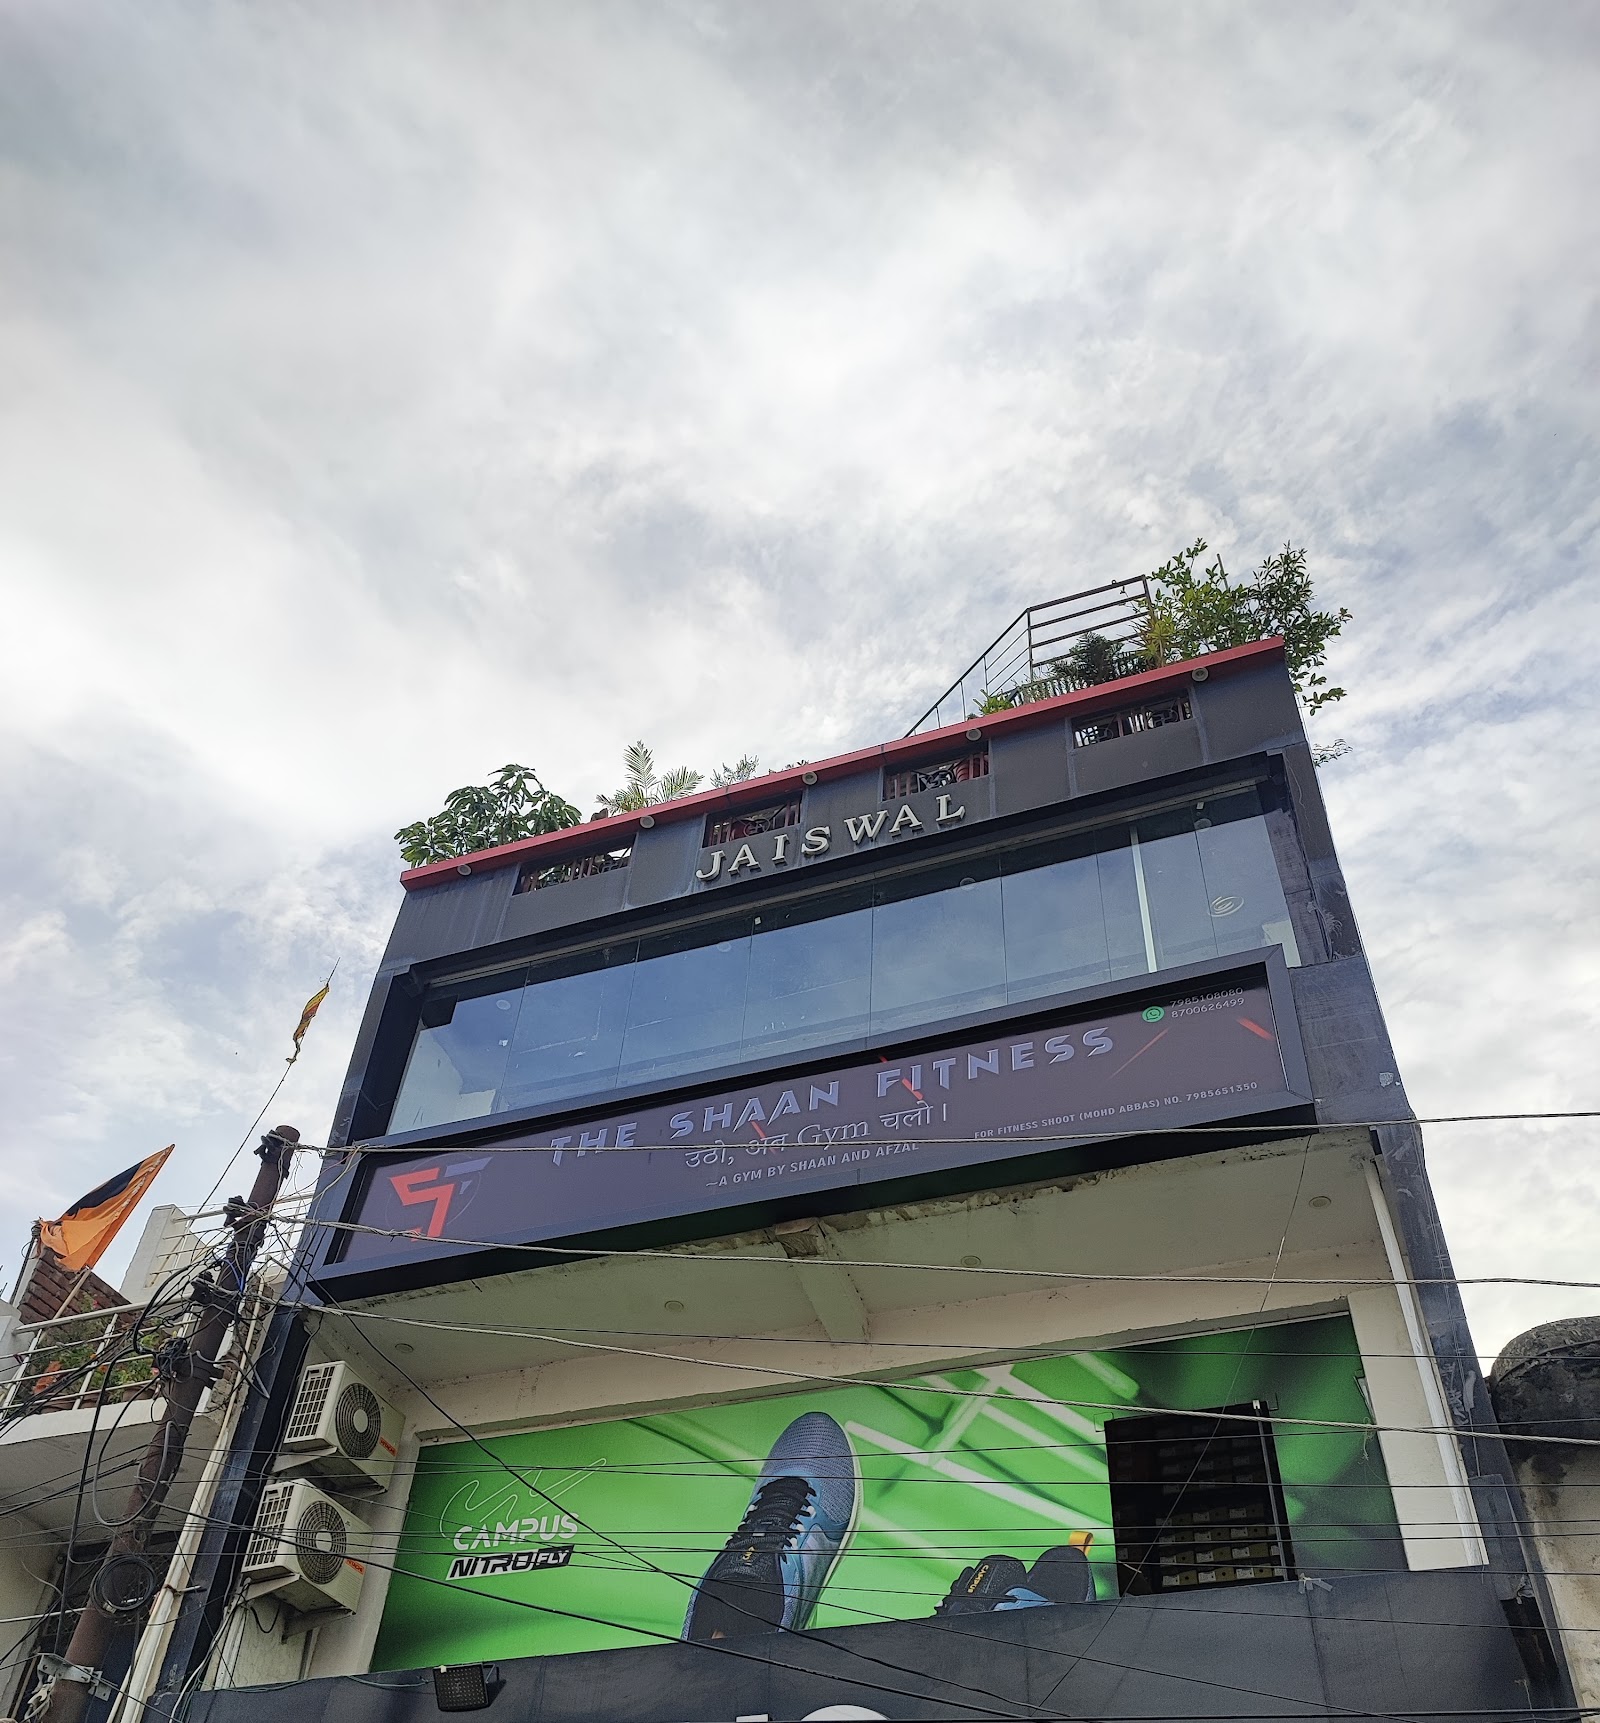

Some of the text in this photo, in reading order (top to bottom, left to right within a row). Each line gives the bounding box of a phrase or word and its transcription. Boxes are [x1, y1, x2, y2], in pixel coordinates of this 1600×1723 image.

[696, 794, 966, 881] JAISWAL
[1169, 987, 1244, 1009] 7985108080
[1171, 997, 1245, 1018] 8700626499
[551, 1026, 1114, 1167] THE SHAAN FITNESS
[974, 1081, 1259, 1139] FOR FITNESS SHOOT (MOHD ABBAS) NO. 7985651350
[797, 1120, 871, 1151] Gym
[732, 1169, 762, 1184] GYM
[766, 1164, 787, 1177] BY
[790, 1155, 837, 1172] SHAAN
[841, 1149, 871, 1163] AND
[875, 1142, 920, 1158] AFZAL
[453, 1512, 580, 1551] CAMPUS
